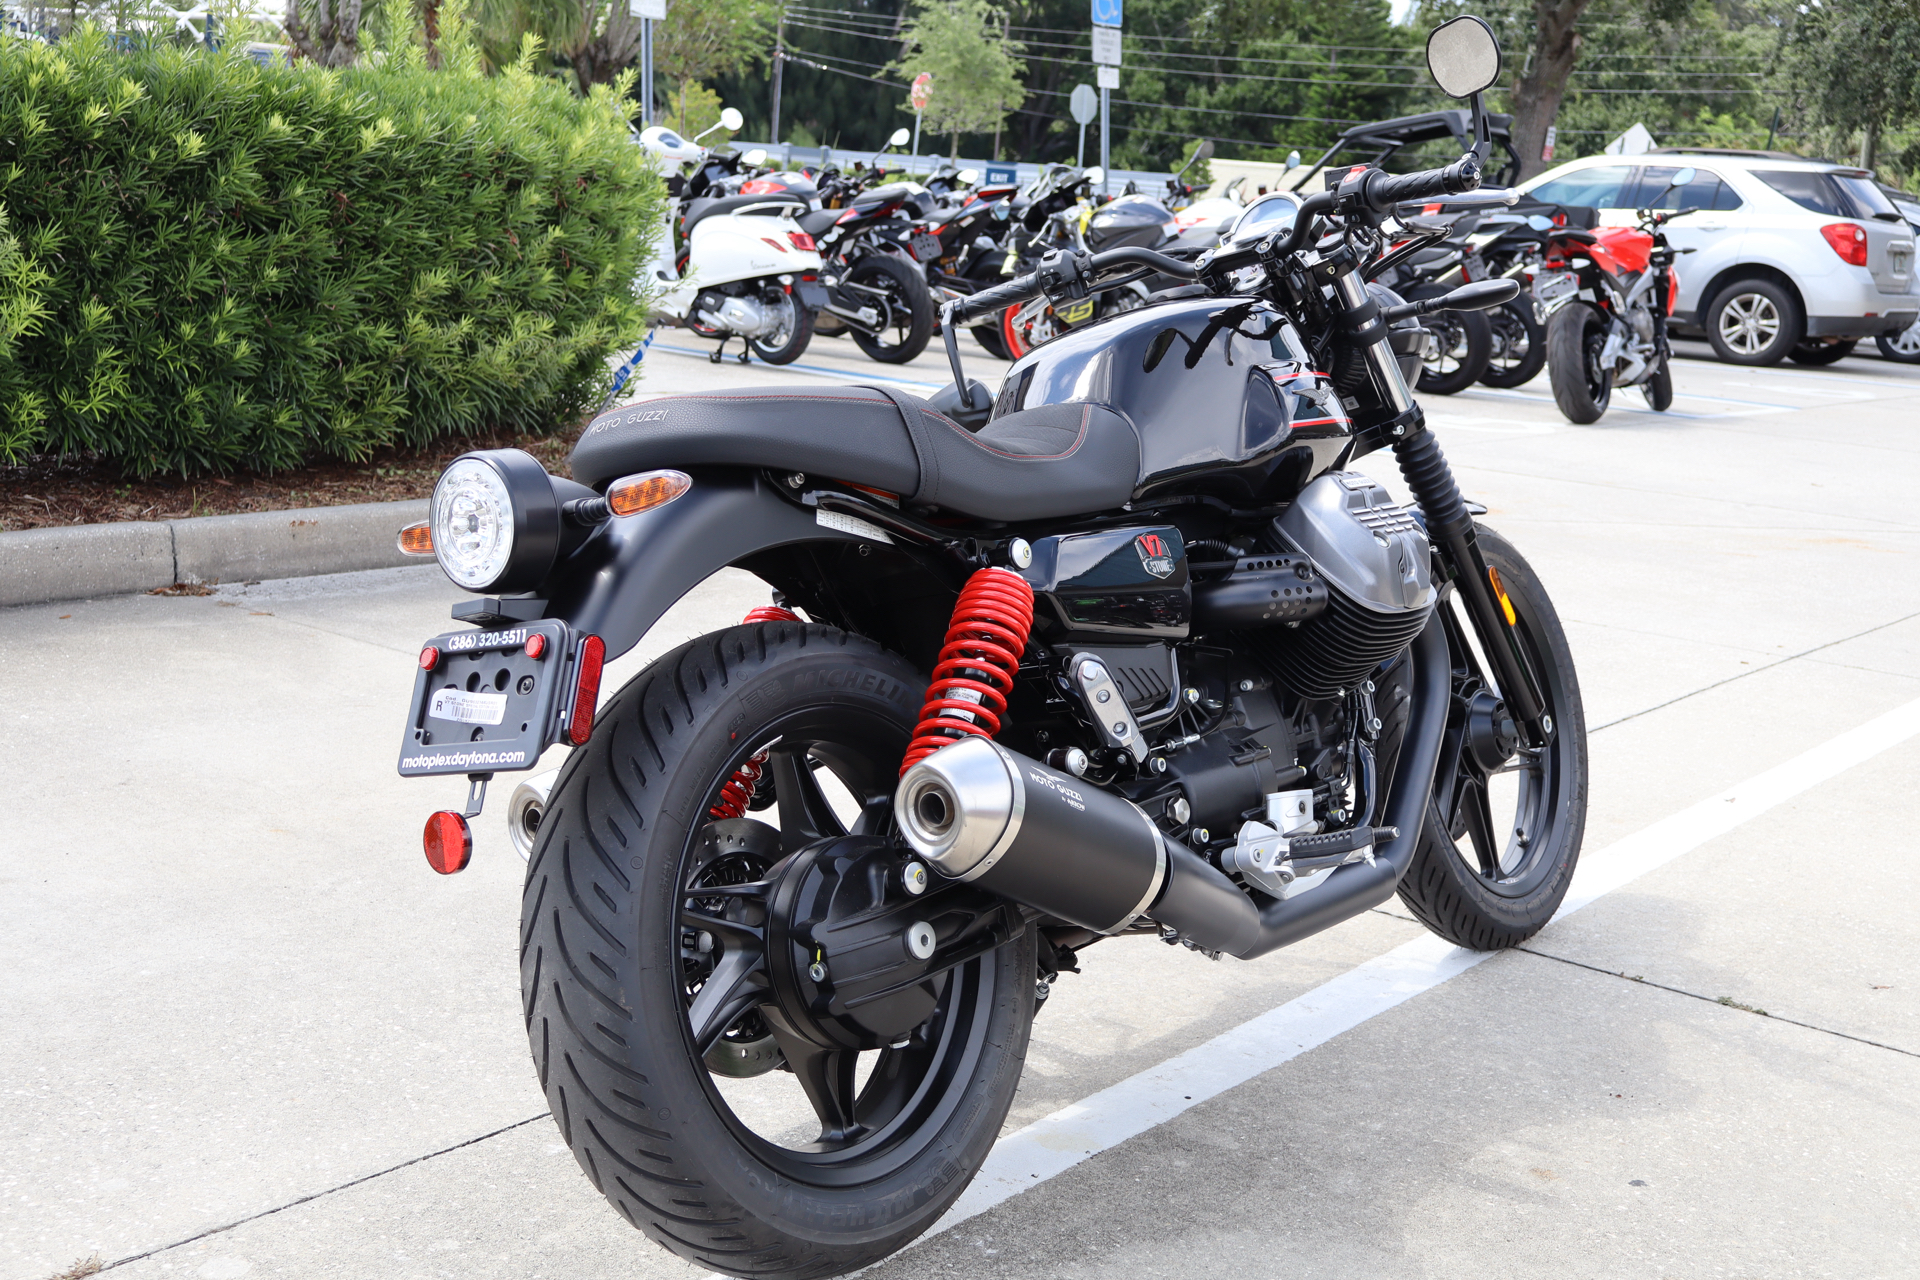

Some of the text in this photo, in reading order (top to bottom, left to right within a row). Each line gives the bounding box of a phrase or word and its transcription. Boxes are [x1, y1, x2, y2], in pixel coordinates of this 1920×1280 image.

[990, 172, 1009, 183] EXIT
[588, 409, 669, 437] MOTO GUZZI
[1138, 534, 1163, 557] V7
[1149, 560, 1172, 573] STONE
[448, 629, 527, 650] (386) 320-5511
[792, 669, 922, 708] MICHELIN
[435, 700, 443, 712] R
[401, 750, 526, 770] motoplexdaytona.com
[1029, 772, 1084, 802] MOTO GUZZI
